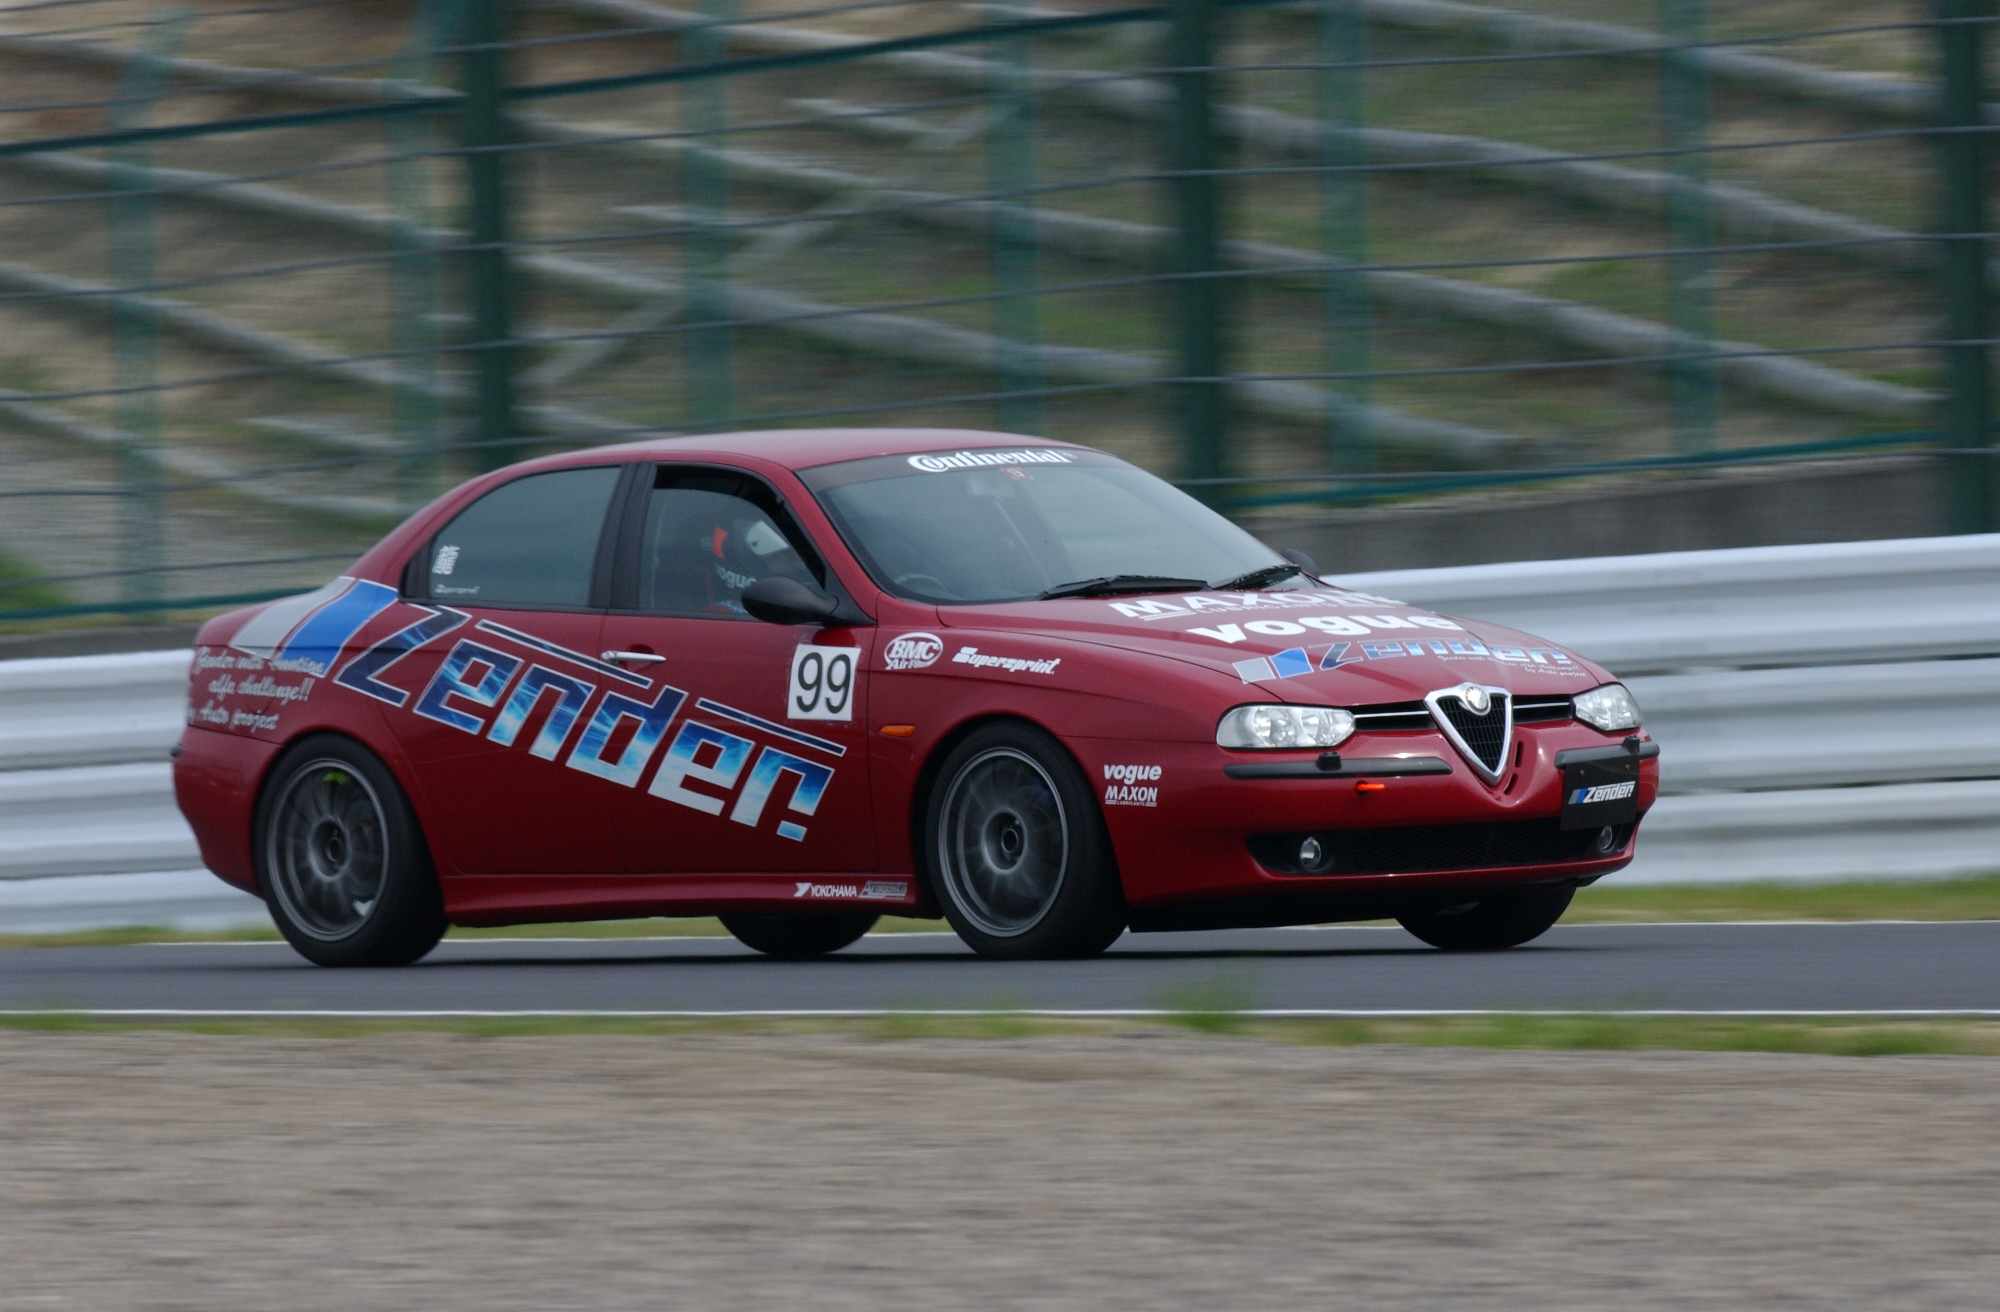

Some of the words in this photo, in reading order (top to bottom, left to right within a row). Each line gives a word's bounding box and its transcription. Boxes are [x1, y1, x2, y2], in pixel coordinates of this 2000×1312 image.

[907, 449, 1073, 472] Continental
[1185, 612, 1464, 644] vogue
[888, 639, 941, 660] BMC
[952, 646, 1062, 675] Supersprint
[796, 651, 851, 715] 99
[1103, 764, 1162, 785] vogue
[1104, 785, 1158, 803] MAXON
[811, 884, 857, 897] YOKOHAMA
